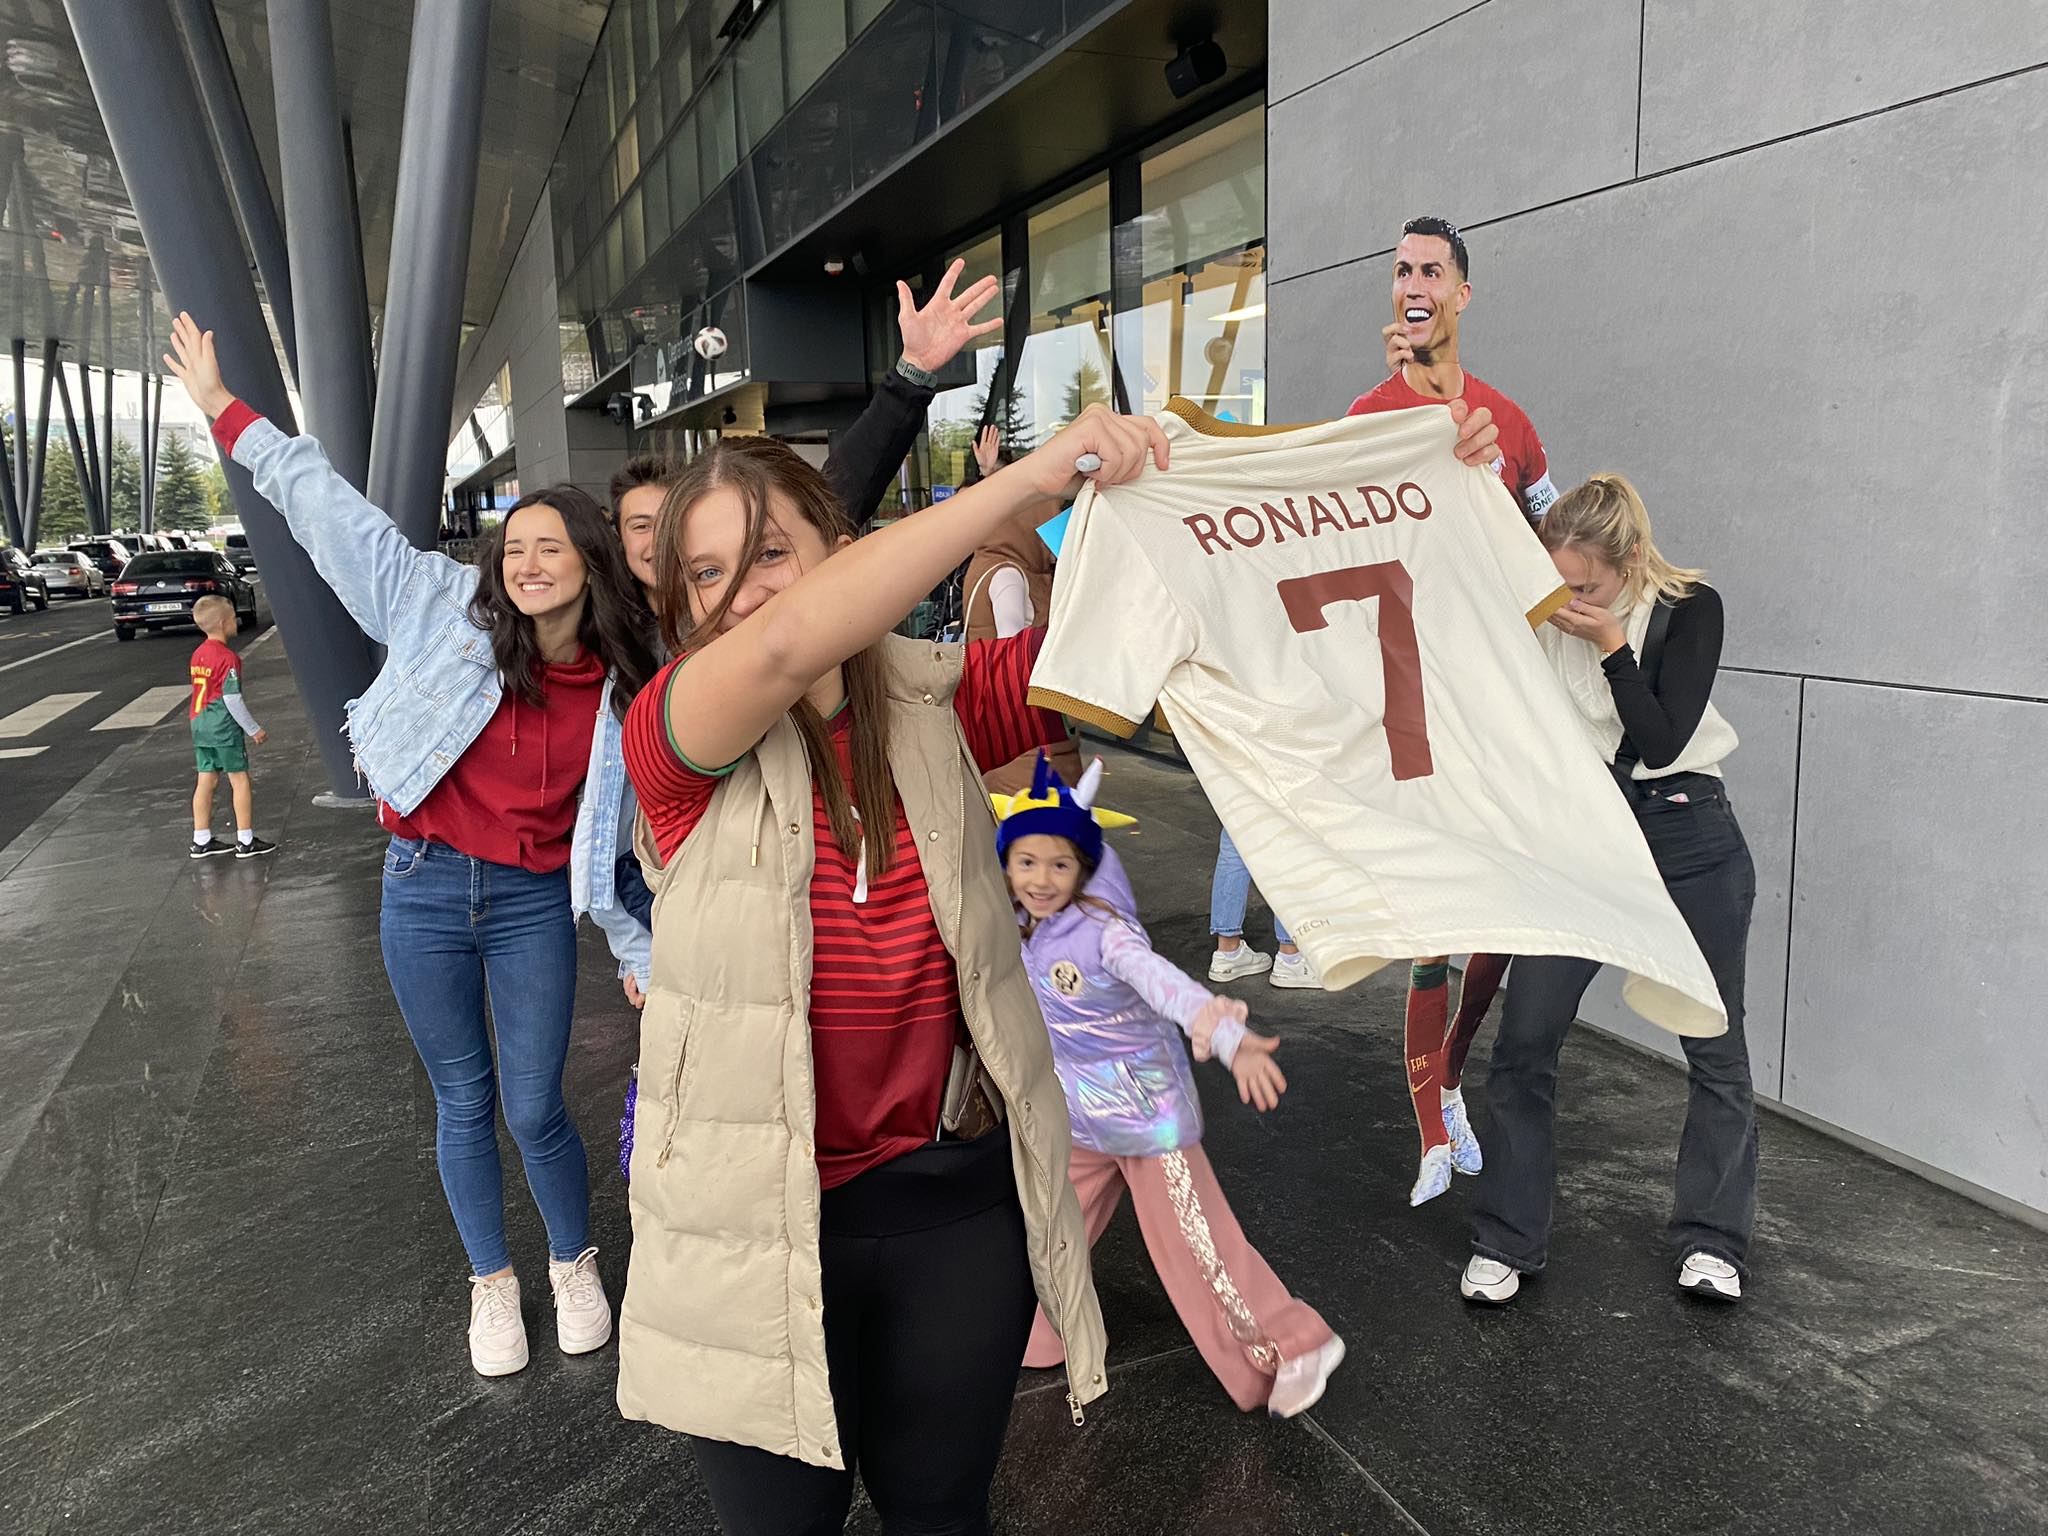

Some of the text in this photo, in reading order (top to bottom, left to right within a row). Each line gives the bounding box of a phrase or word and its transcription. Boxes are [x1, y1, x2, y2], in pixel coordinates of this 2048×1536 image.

[1182, 481, 1432, 555] RONALDO
[194, 677, 206, 713] 7
[1276, 558, 1434, 781] 7
[1296, 918, 1331, 937] TECH
